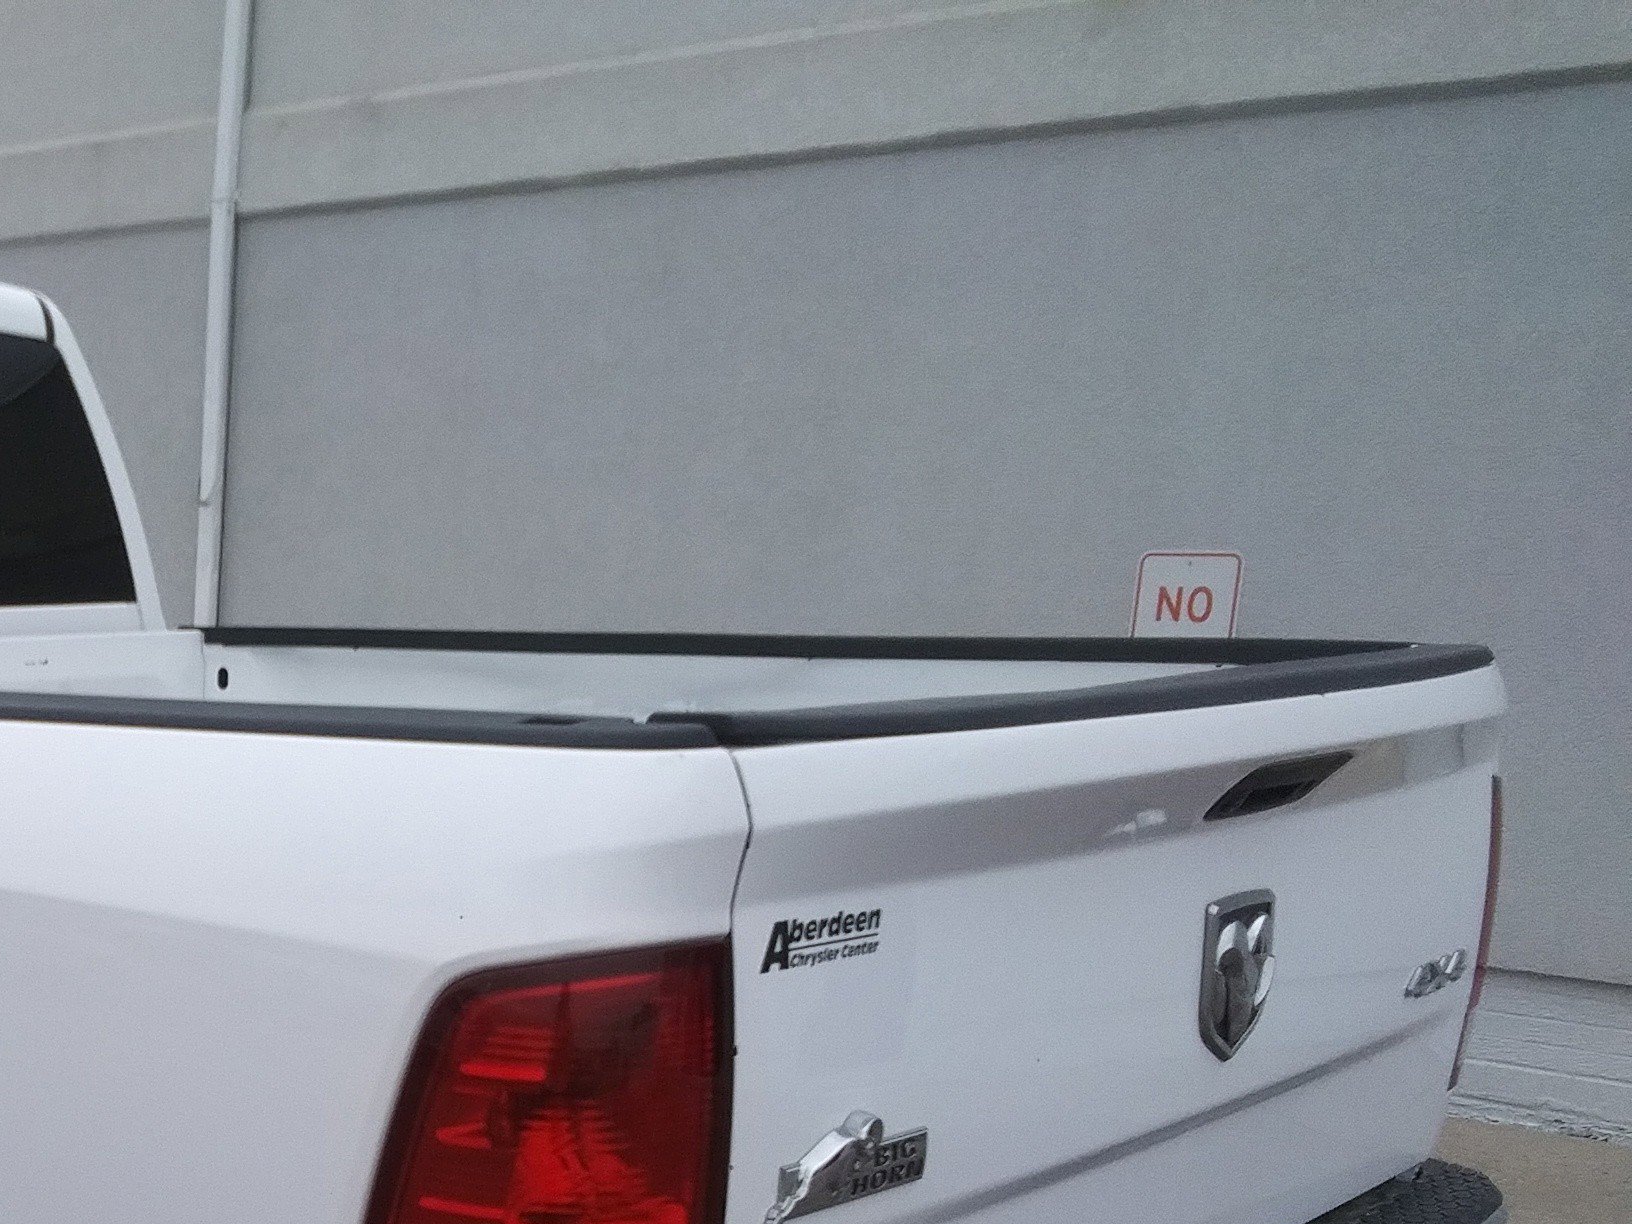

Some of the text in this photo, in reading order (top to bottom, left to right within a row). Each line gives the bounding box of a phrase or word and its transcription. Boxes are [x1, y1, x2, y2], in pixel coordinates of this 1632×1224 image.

[1156, 586, 1213, 623] NO
[760, 908, 882, 974] Aberdeen
[790, 941, 879, 968] Chrysler Center
[874, 1138, 918, 1168] BIG
[851, 1160, 924, 1195] HORN
